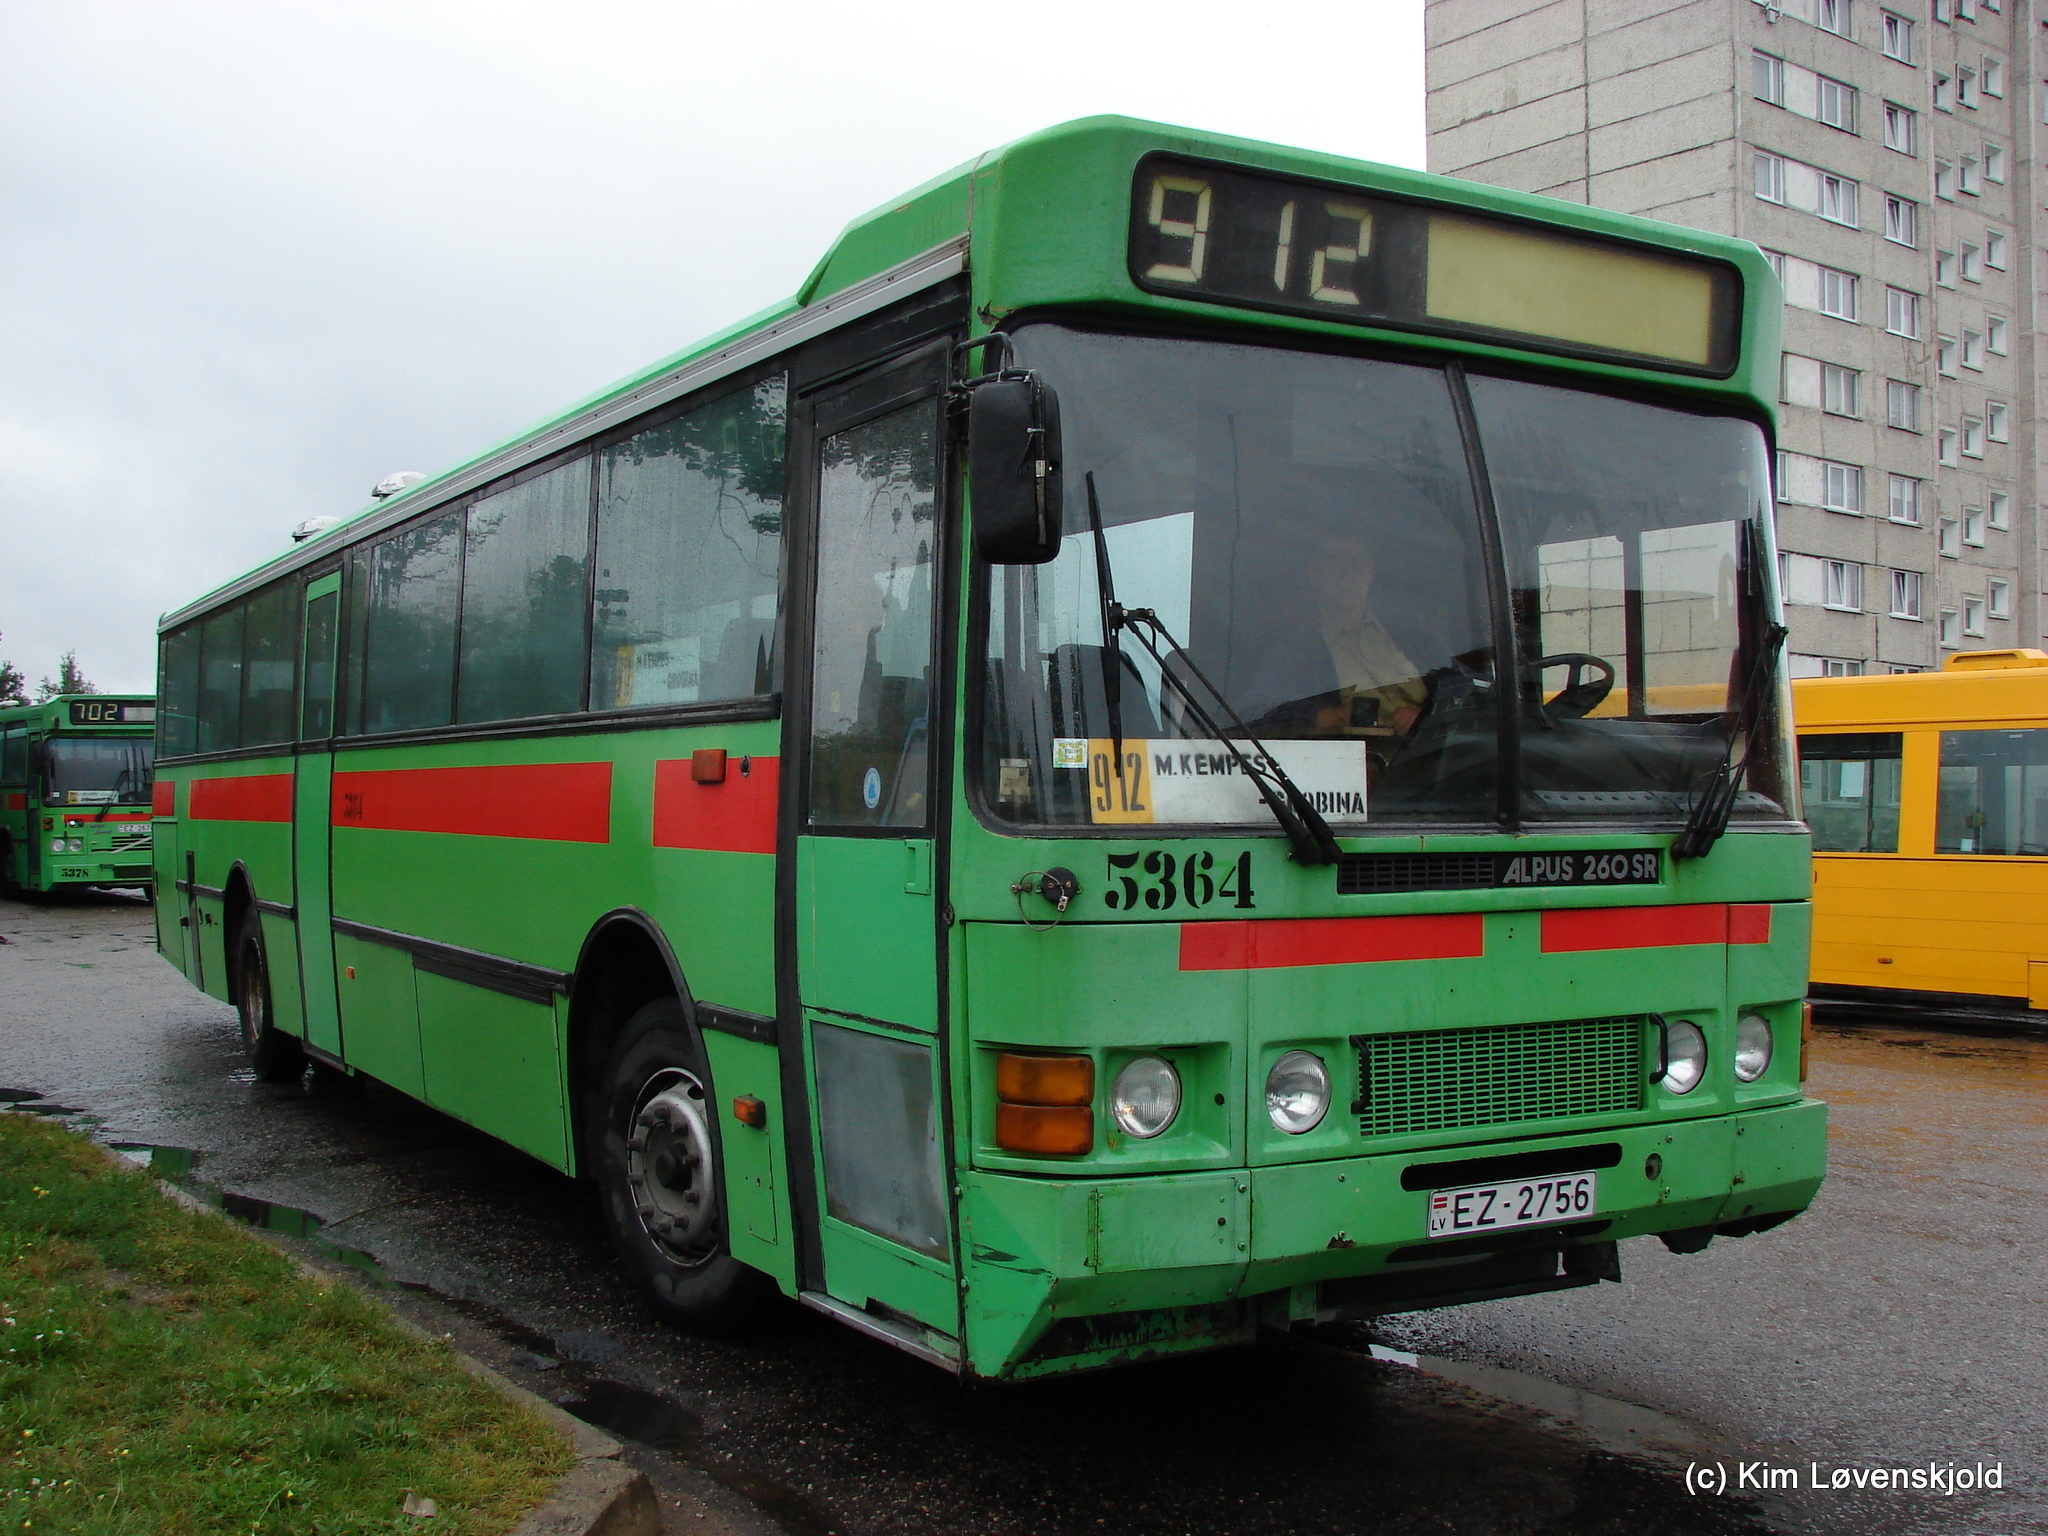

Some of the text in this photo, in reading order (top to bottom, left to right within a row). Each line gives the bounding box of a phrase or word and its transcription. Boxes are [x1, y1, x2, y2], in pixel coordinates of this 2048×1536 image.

[73, 703, 119, 721] 702
[1094, 752, 1146, 813] 912
[61, 868, 90, 878] 5378
[1104, 850, 1256, 911] 5364
[1502, 853, 1657, 884] ALPUS 260 SR
[1431, 1178, 1589, 1231] LV EZ-2756
